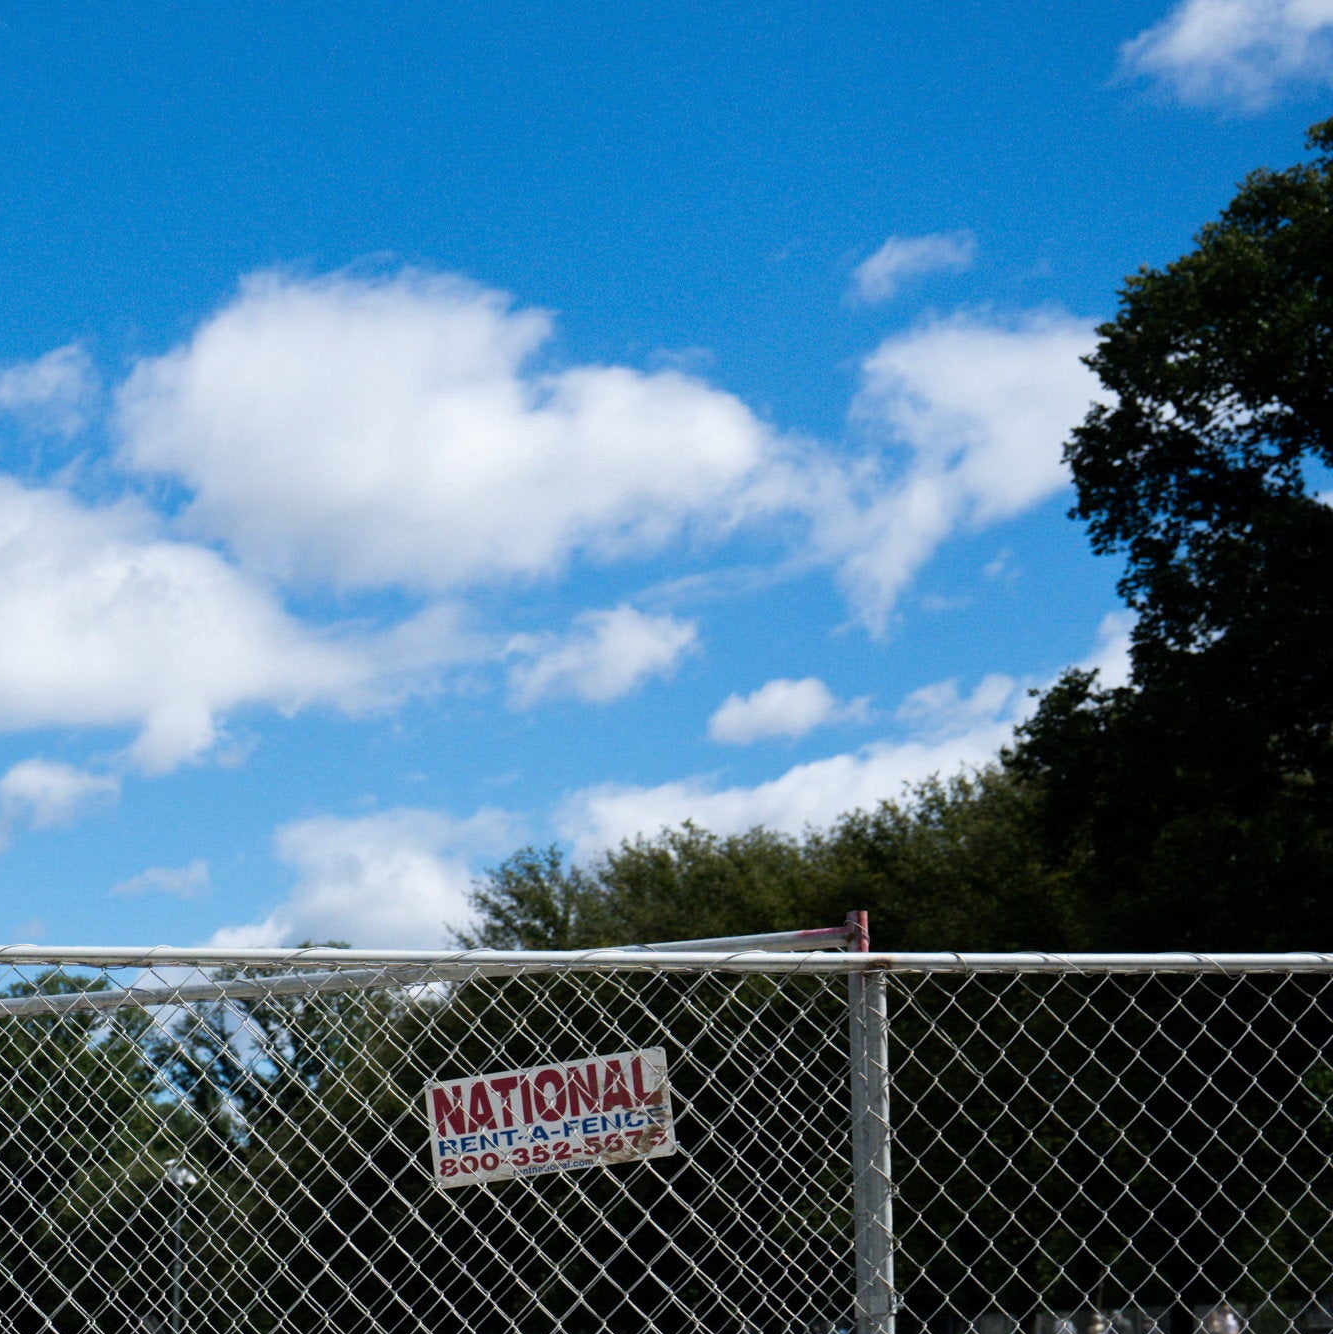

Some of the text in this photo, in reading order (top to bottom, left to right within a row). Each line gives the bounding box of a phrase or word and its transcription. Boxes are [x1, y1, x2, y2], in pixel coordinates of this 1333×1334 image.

[433, 1056, 663, 1138] NATIONAL
[438, 1107, 665, 1156] RENT-A-FENCE
[440, 1131, 668, 1177] 800-352-5675
